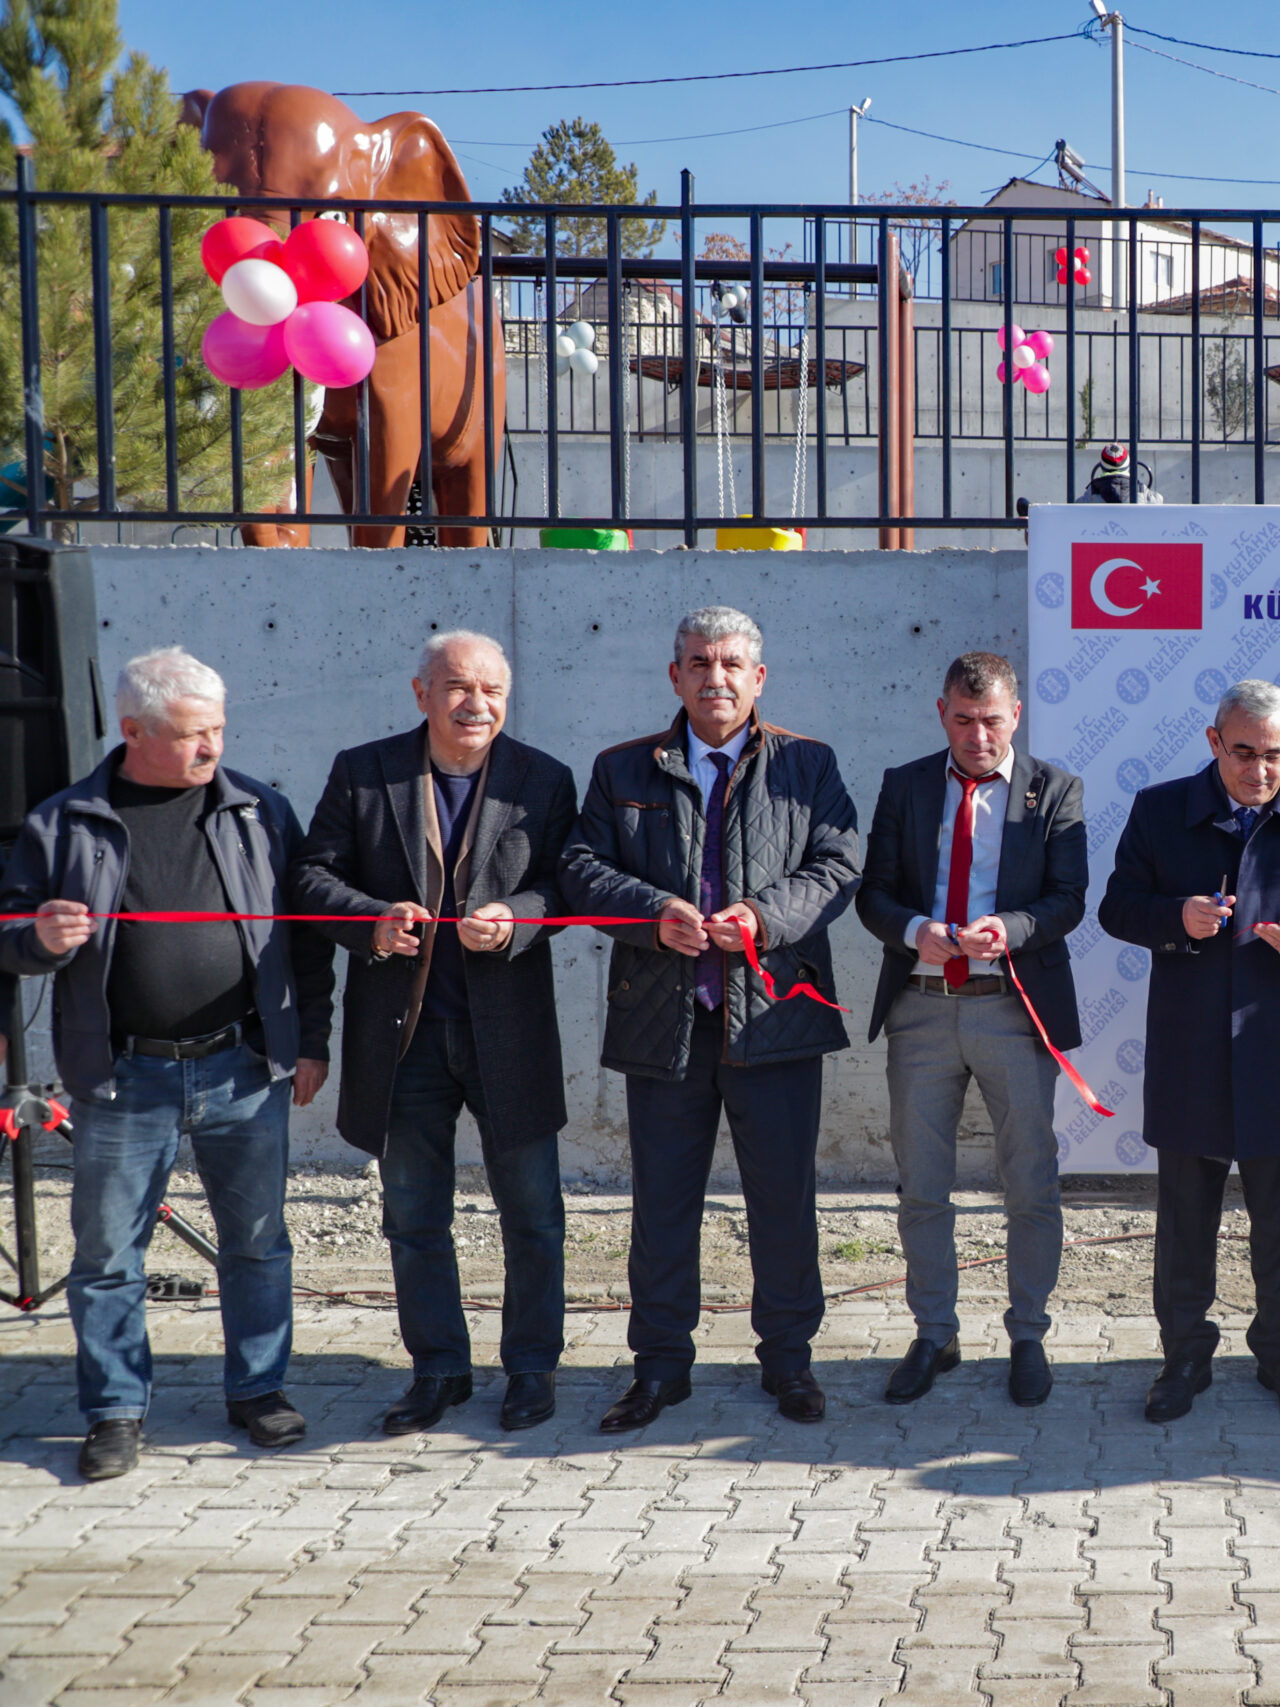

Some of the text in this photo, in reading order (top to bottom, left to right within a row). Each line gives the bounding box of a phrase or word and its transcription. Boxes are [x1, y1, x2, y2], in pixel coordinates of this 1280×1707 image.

[1231, 530, 1253, 550] T.C.
[1231, 625, 1253, 645] T.C.
[1074, 715, 1096, 736] T.C.
[1153, 715, 1175, 735] T.C.
